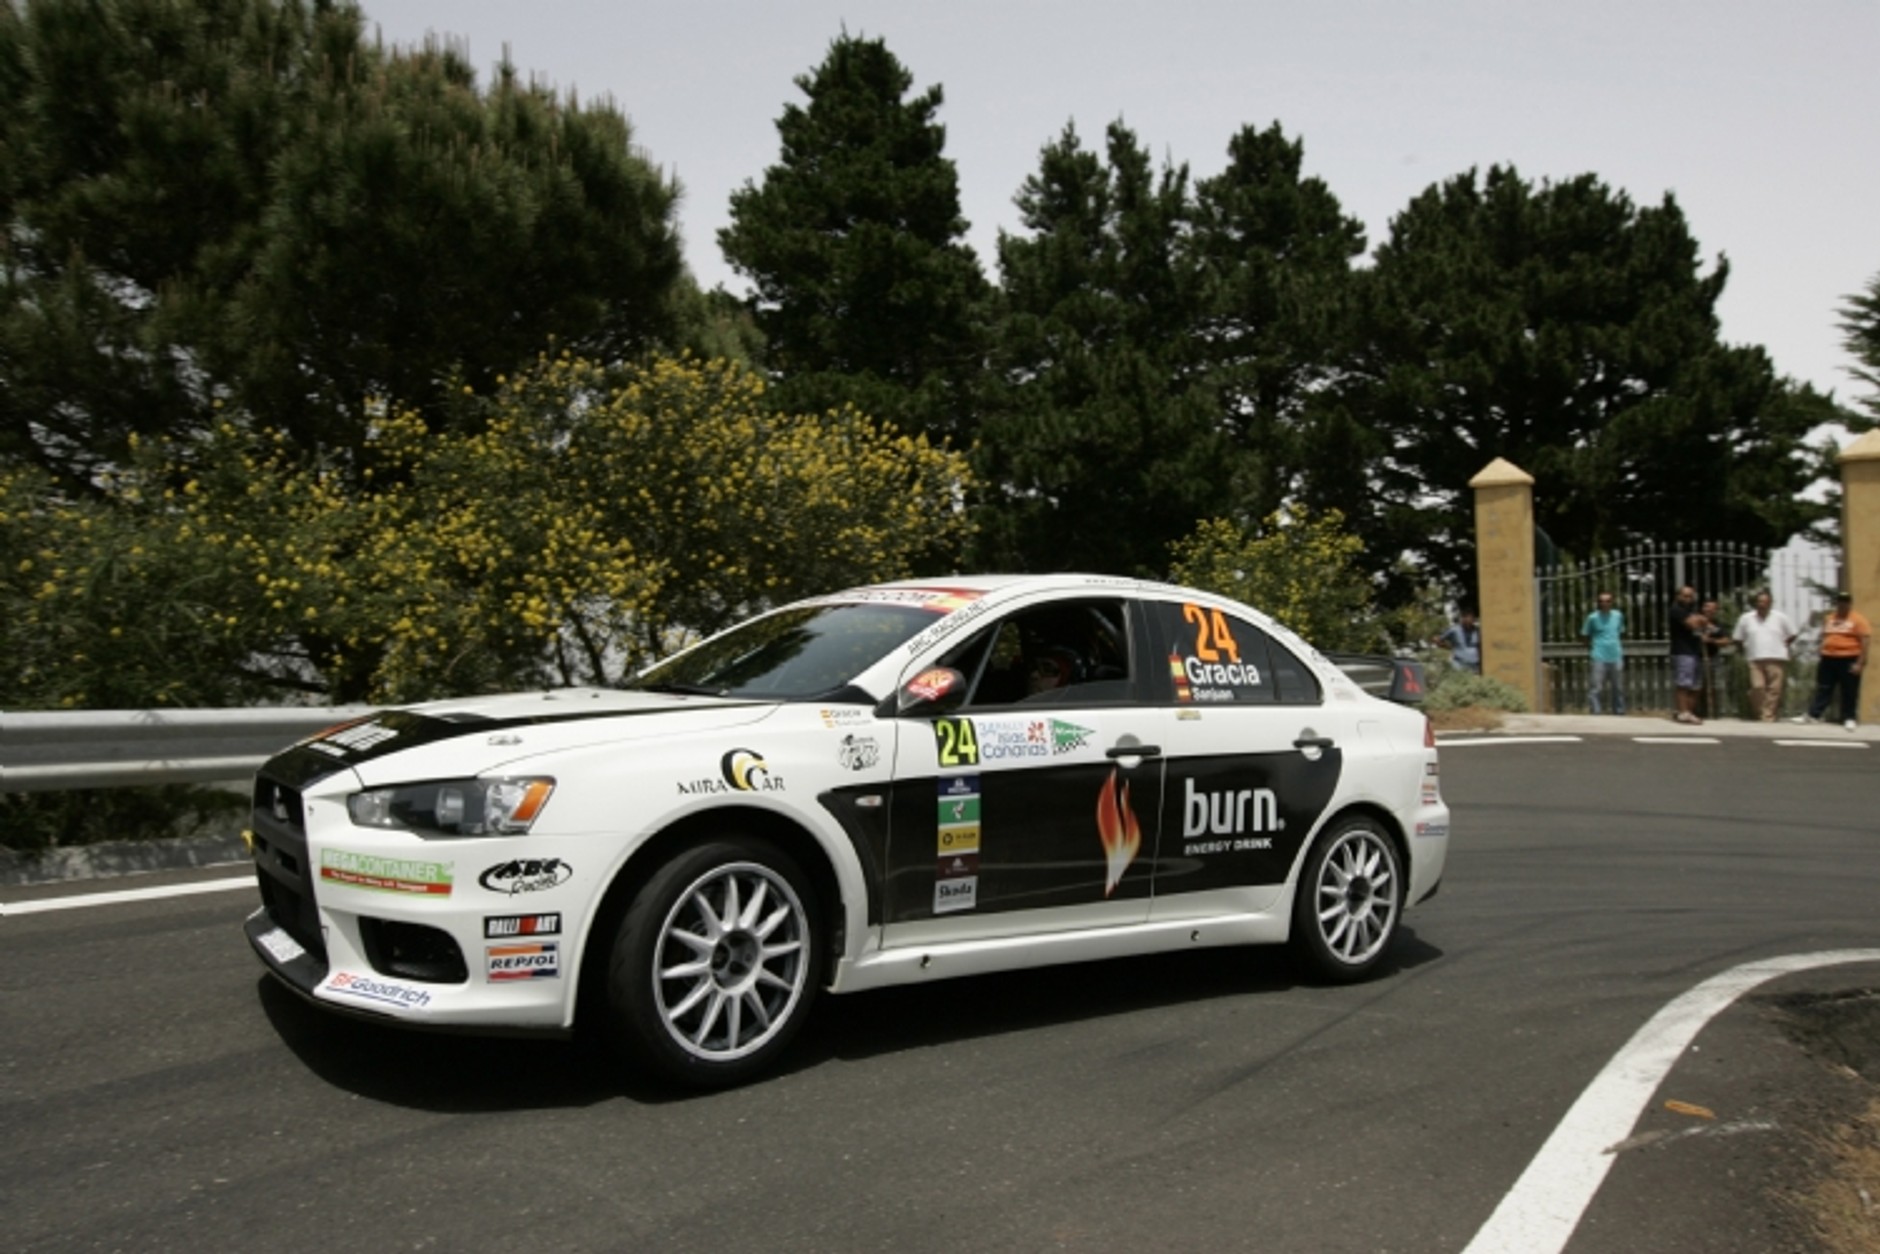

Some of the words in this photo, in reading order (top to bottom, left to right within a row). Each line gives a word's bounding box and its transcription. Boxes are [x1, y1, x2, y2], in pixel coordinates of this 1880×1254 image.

[1183, 602, 1240, 662] 24
[1185, 656, 1261, 685] Gracia
[936, 717, 976, 766] 24
[1184, 841, 1232, 855] ENERGY
[1233, 838, 1272, 850] DRINK
[491, 955, 556, 969] REPSOL
[330, 972, 432, 1007] BFGoodrich
